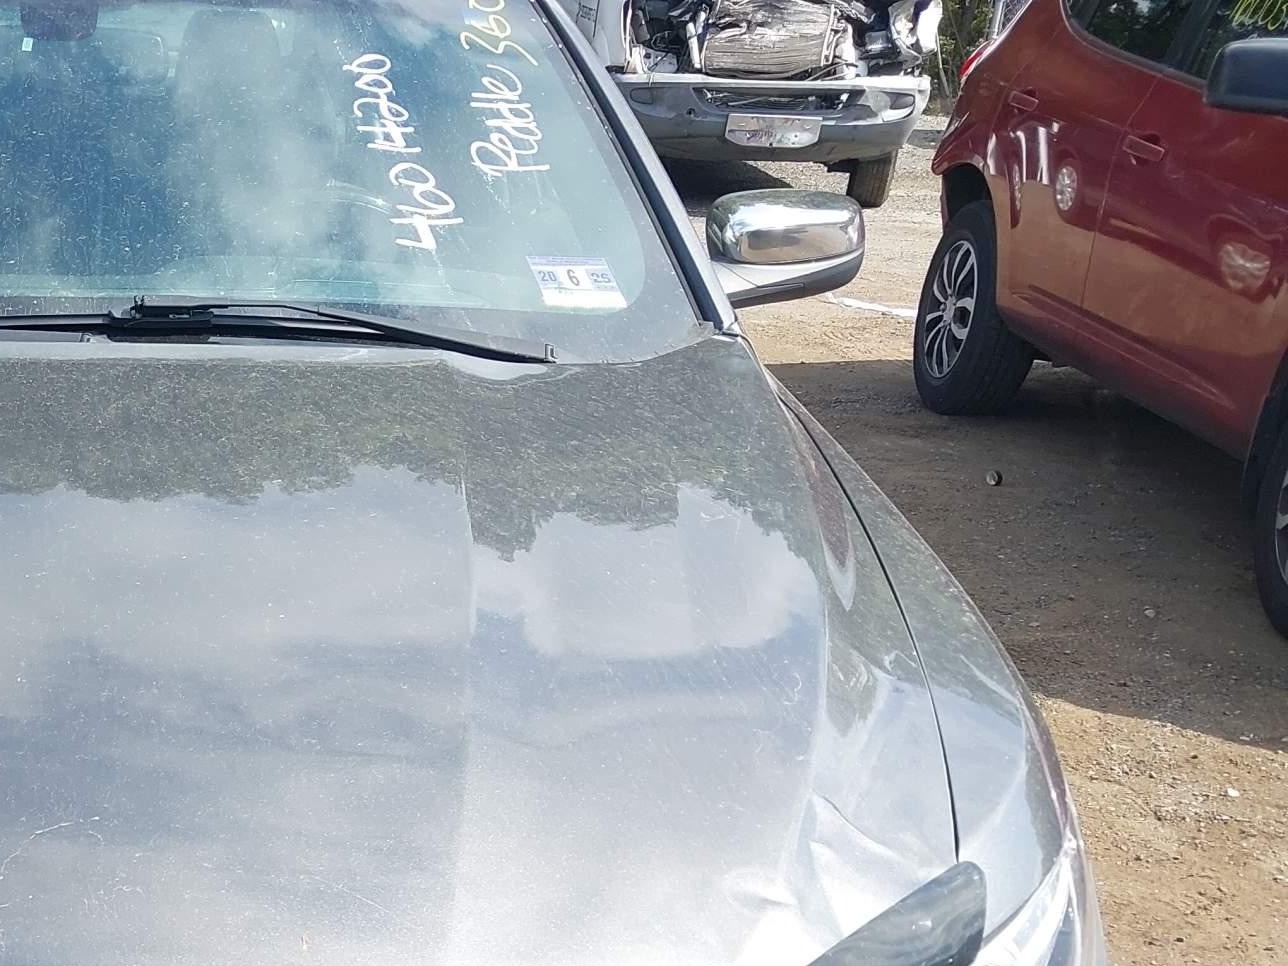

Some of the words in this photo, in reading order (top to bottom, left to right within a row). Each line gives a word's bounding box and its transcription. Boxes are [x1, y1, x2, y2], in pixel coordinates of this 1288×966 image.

[469, 64, 551, 174] Peddle
[537, 270, 558, 282] 20
[566, 268, 580, 287] 6
